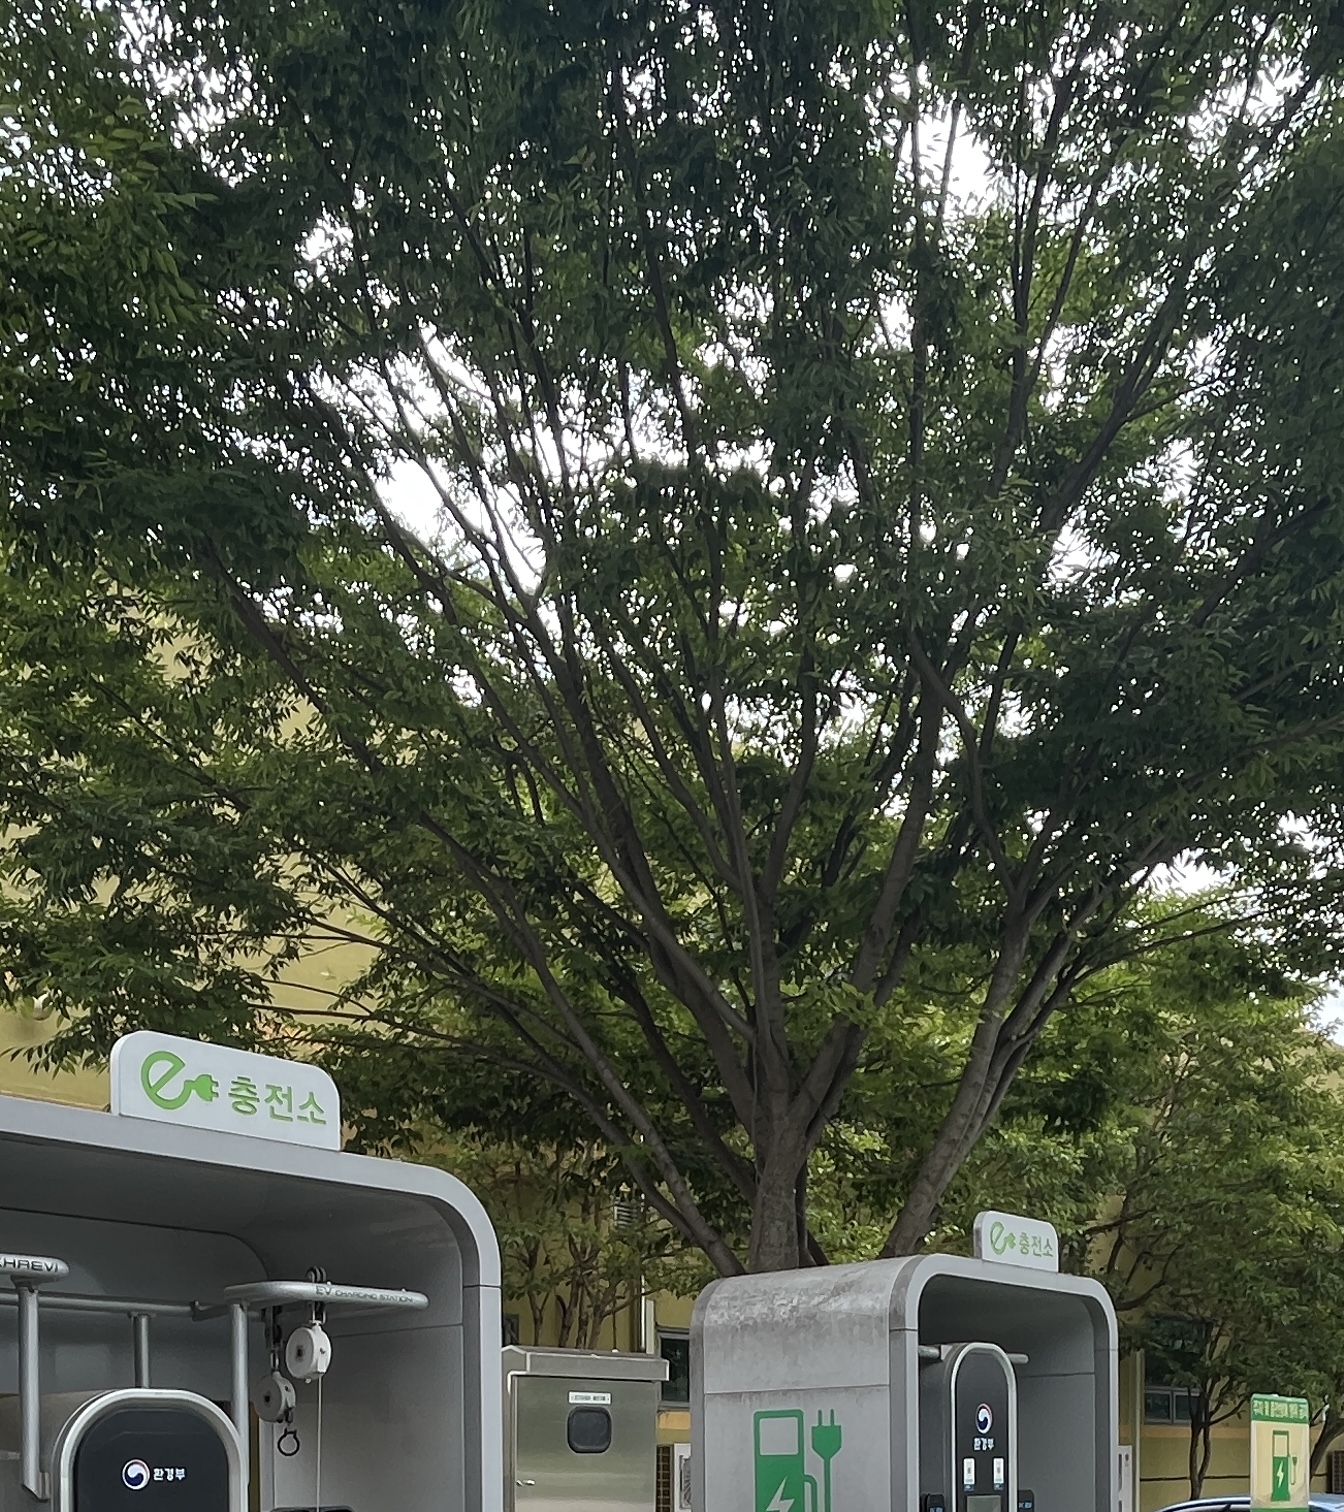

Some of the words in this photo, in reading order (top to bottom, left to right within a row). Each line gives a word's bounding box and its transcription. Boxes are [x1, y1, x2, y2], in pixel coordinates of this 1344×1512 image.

[227, 1075, 327, 1126] 충전소
[1019, 1231, 1054, 1258] 충전소
[316, 1285, 333, 1296] EV
[153, 1467, 186, 1481] 환경부
